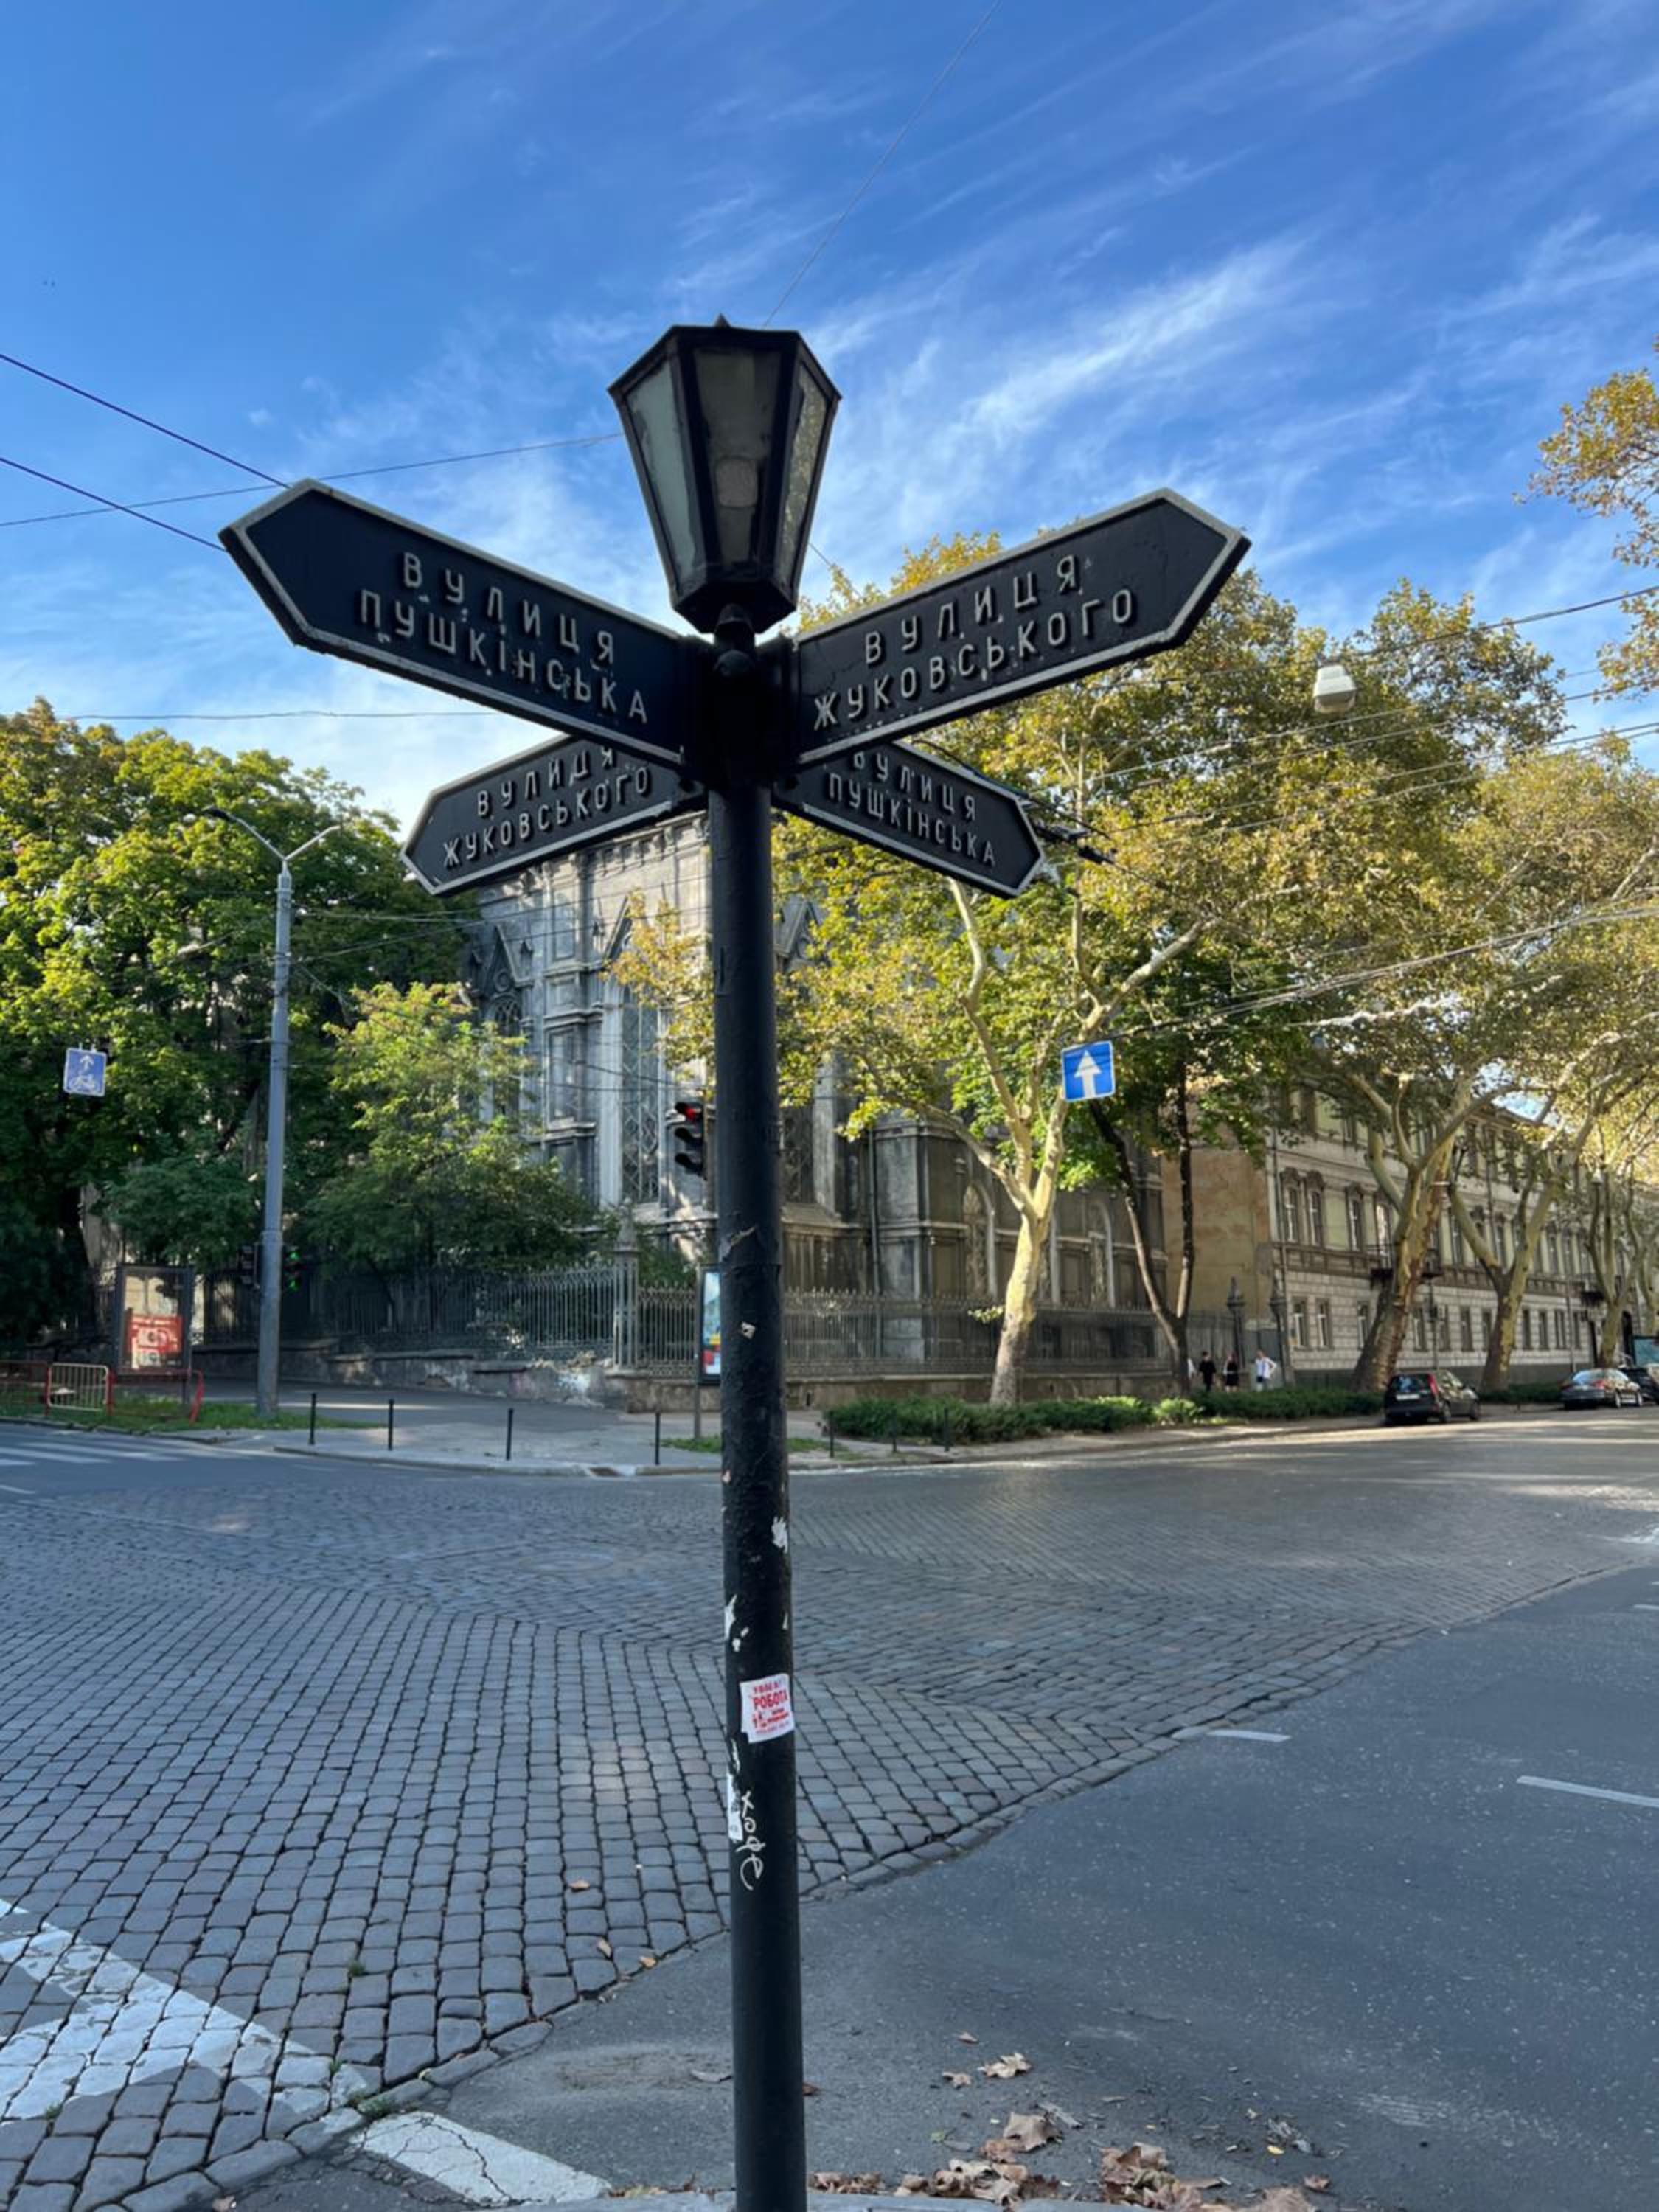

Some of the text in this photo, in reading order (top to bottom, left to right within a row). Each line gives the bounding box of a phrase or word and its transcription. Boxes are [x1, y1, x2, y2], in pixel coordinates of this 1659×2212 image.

[361, 589, 647, 724] ПУШКІНСЬКА
[404, 552, 613, 665] ВУЛИЦЯ
[814, 589, 1133, 732] ЖУКОВСЬКОГО
[865, 555, 1077, 664] ВУЛИЦЯ
[444, 766, 649, 868] ЖУКОВСЬКОГО
[478, 745, 613, 815] ВУЛИЦЯ
[829, 772, 996, 867] ПУШКІНСЬКА
